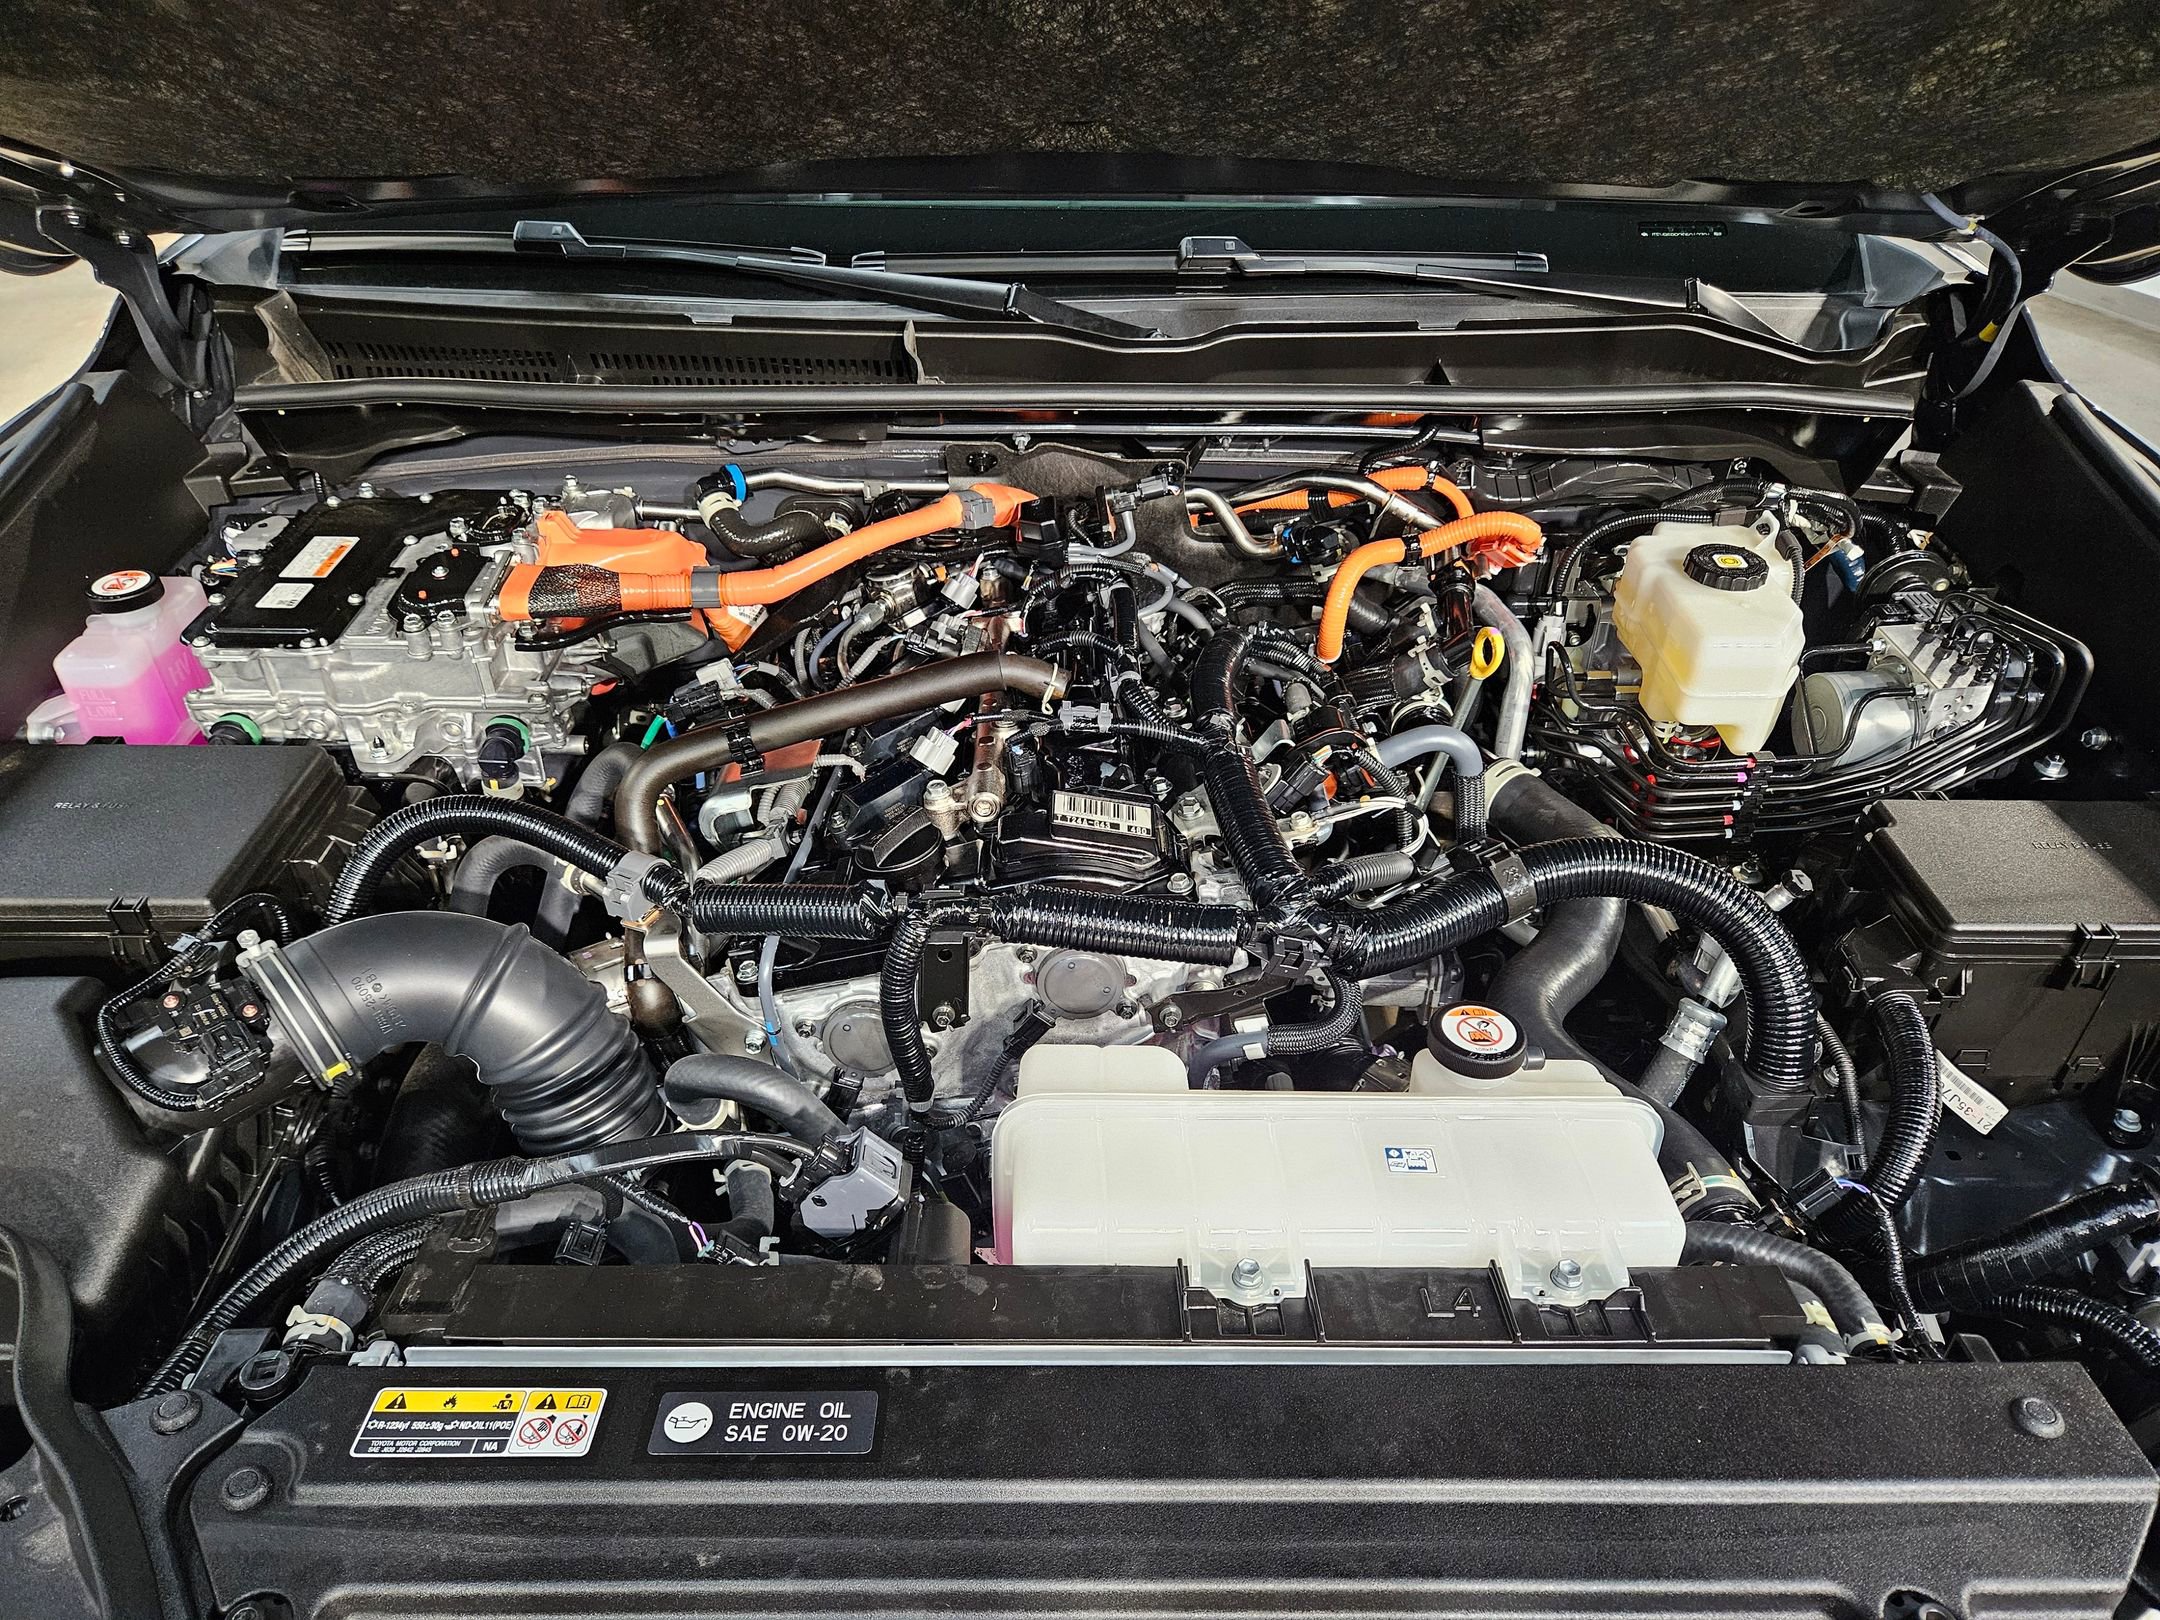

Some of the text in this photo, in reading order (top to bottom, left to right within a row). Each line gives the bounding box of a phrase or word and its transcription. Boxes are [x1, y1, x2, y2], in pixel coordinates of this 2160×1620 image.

[85, 705, 117, 718] LOW
[1419, 1287, 1482, 1318] L4
[728, 1402, 852, 1419] ENGINE OIL
[377, 1420, 410, 1431] R-1234yf
[724, 1424, 848, 1442] SAE 0W-20
[482, 1441, 498, 1452] NA
